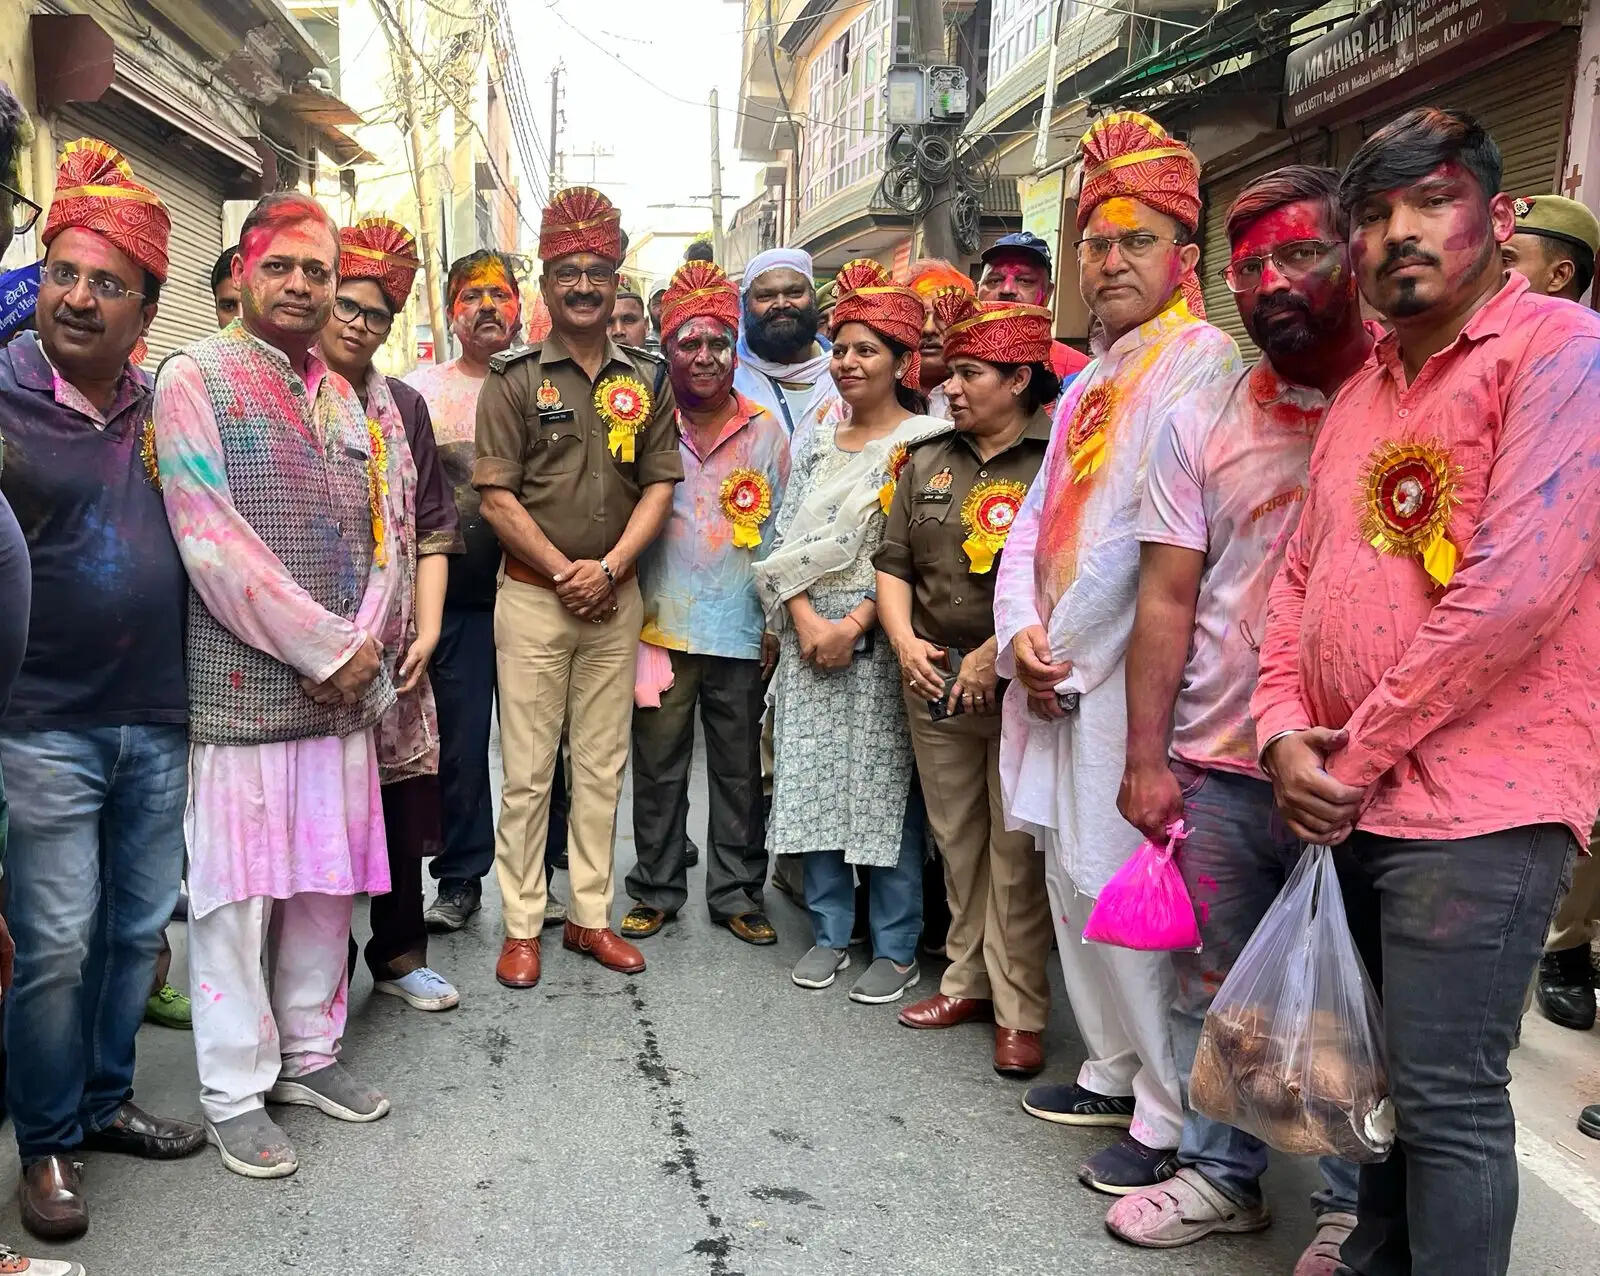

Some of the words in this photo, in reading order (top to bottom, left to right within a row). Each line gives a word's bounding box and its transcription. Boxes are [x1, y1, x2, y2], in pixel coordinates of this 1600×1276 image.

[1289, 66, 1303, 96] Dr.
[1305, 30, 1364, 88] MAZHAR
[1369, 10, 1413, 58] ALAM
[4, 280, 28, 305] होली
